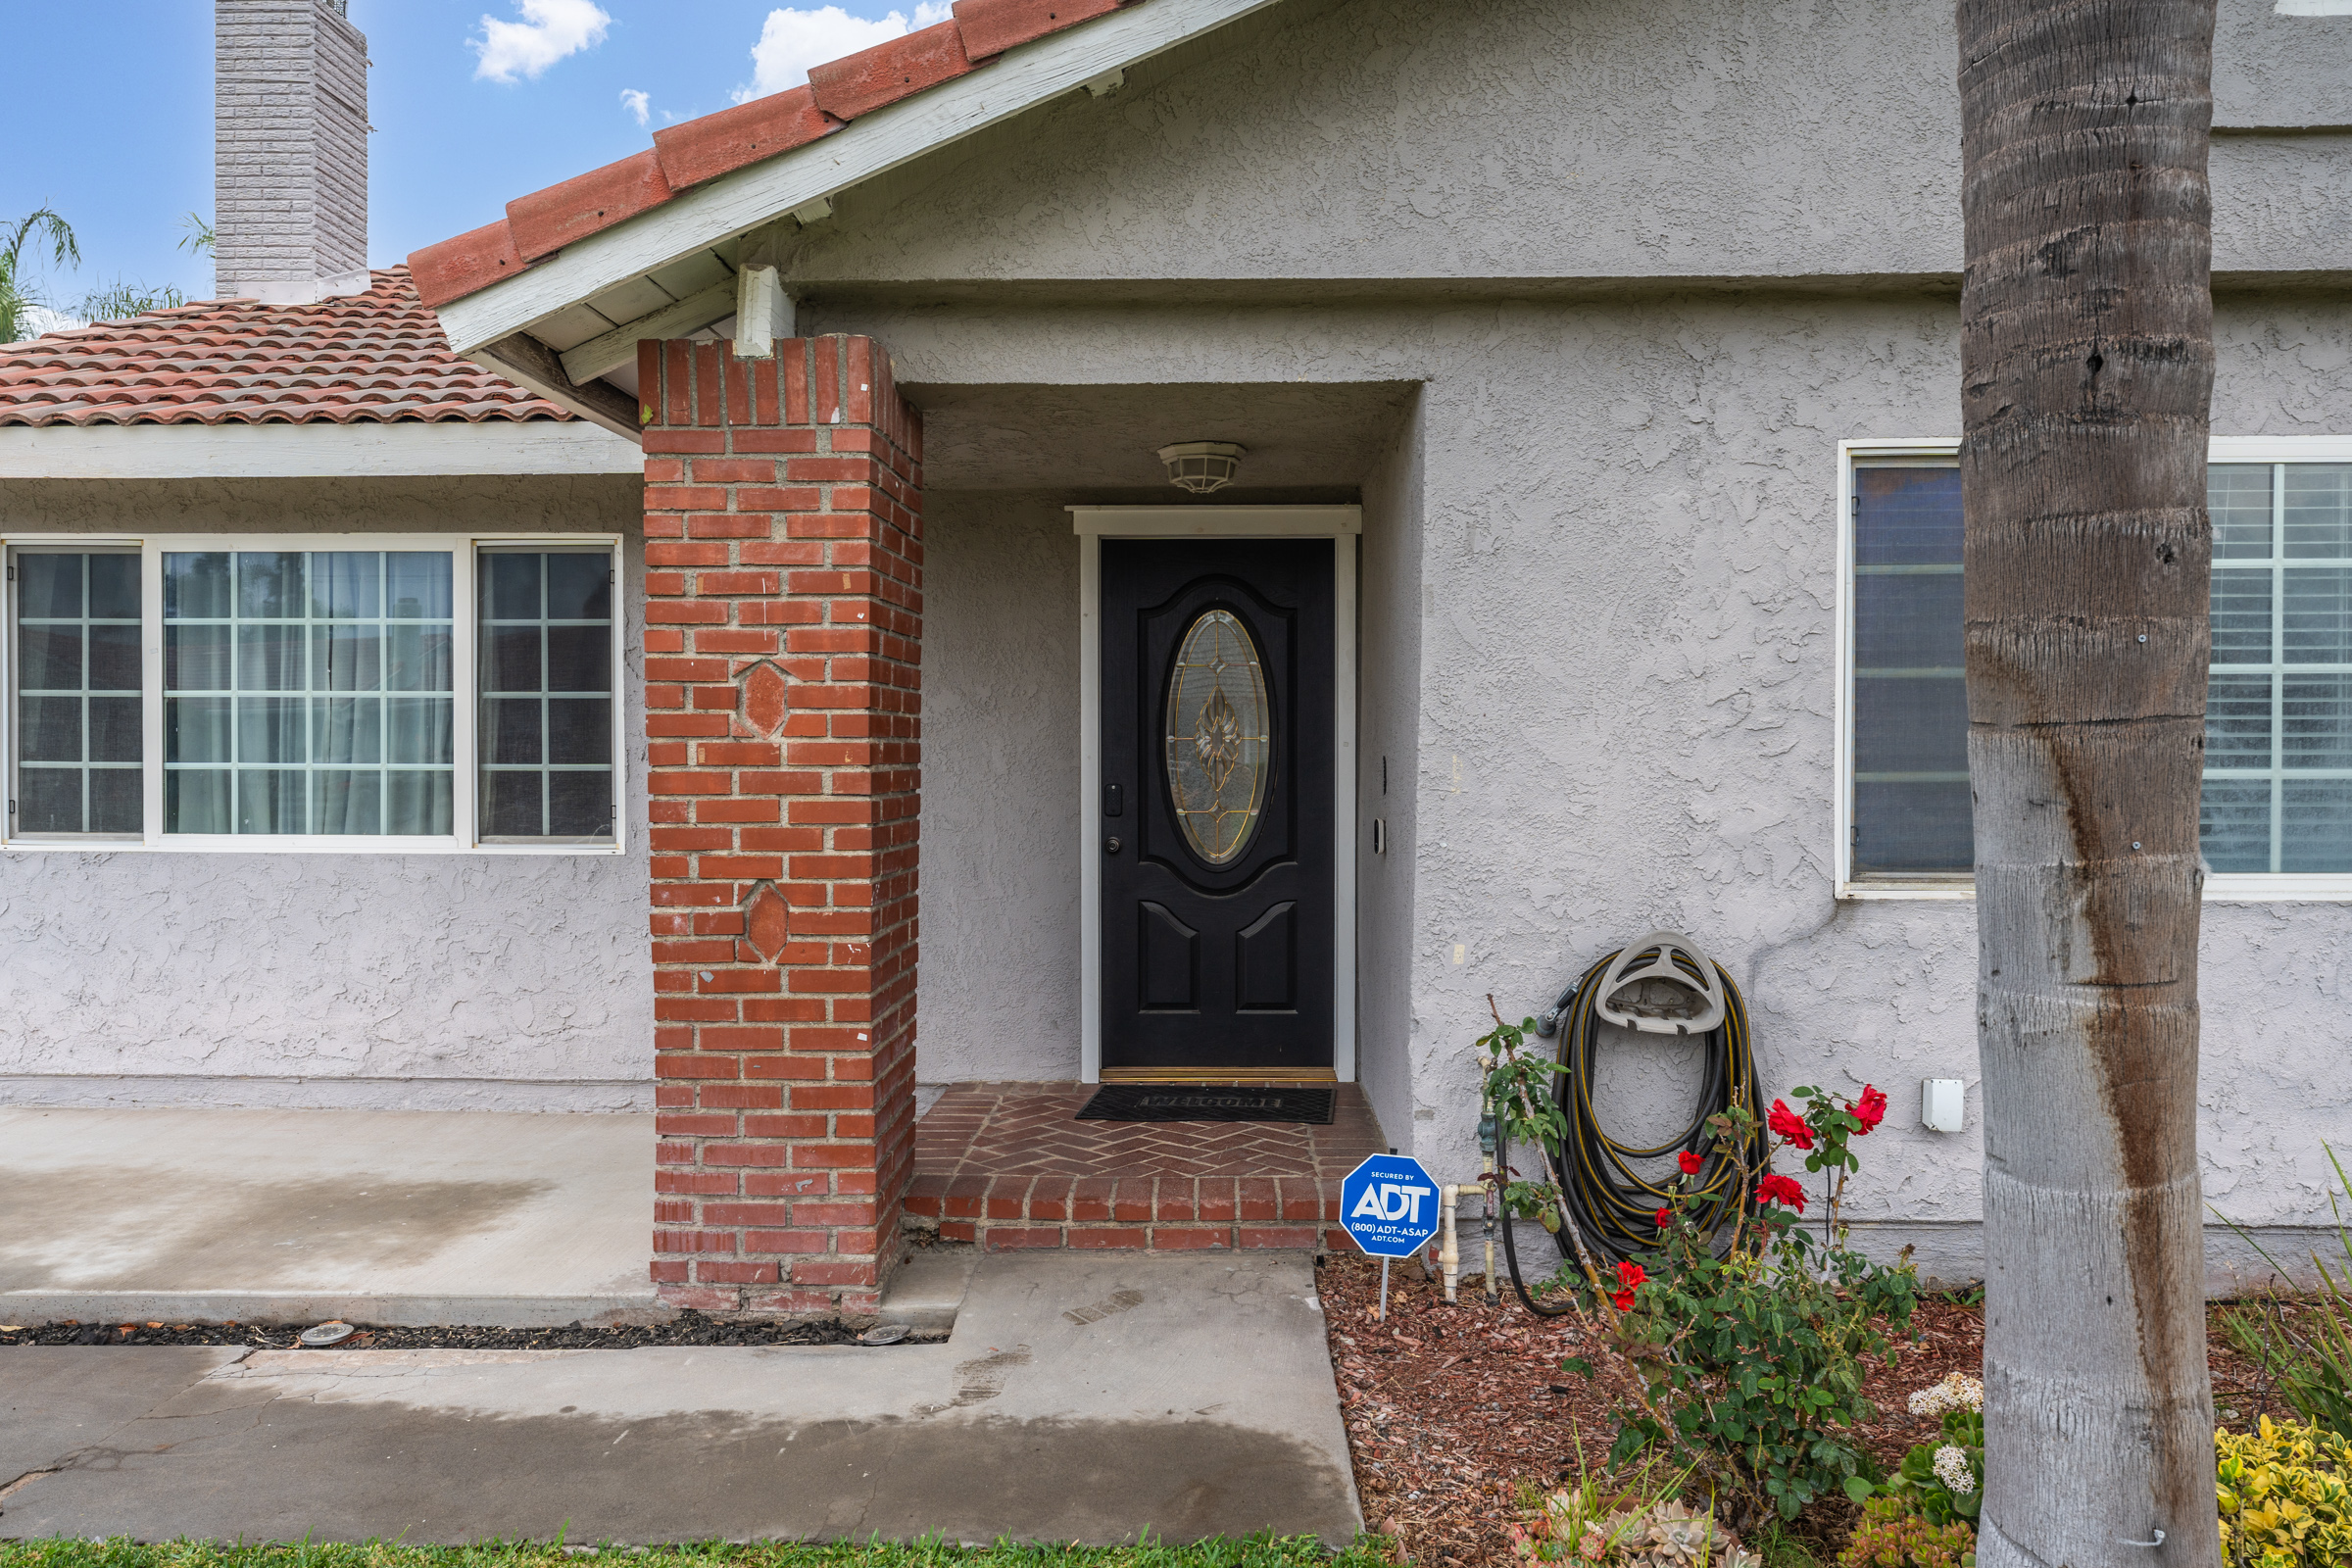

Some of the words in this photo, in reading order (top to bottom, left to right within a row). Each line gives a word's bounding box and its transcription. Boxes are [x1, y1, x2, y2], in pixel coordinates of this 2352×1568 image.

[1145, 1096, 1280, 1107] WELCOME
[1371, 1171, 1403, 1180] SECURED
[1350, 1183, 1431, 1223] ADT
[1371, 1235, 1405, 1244] ADT.COM
